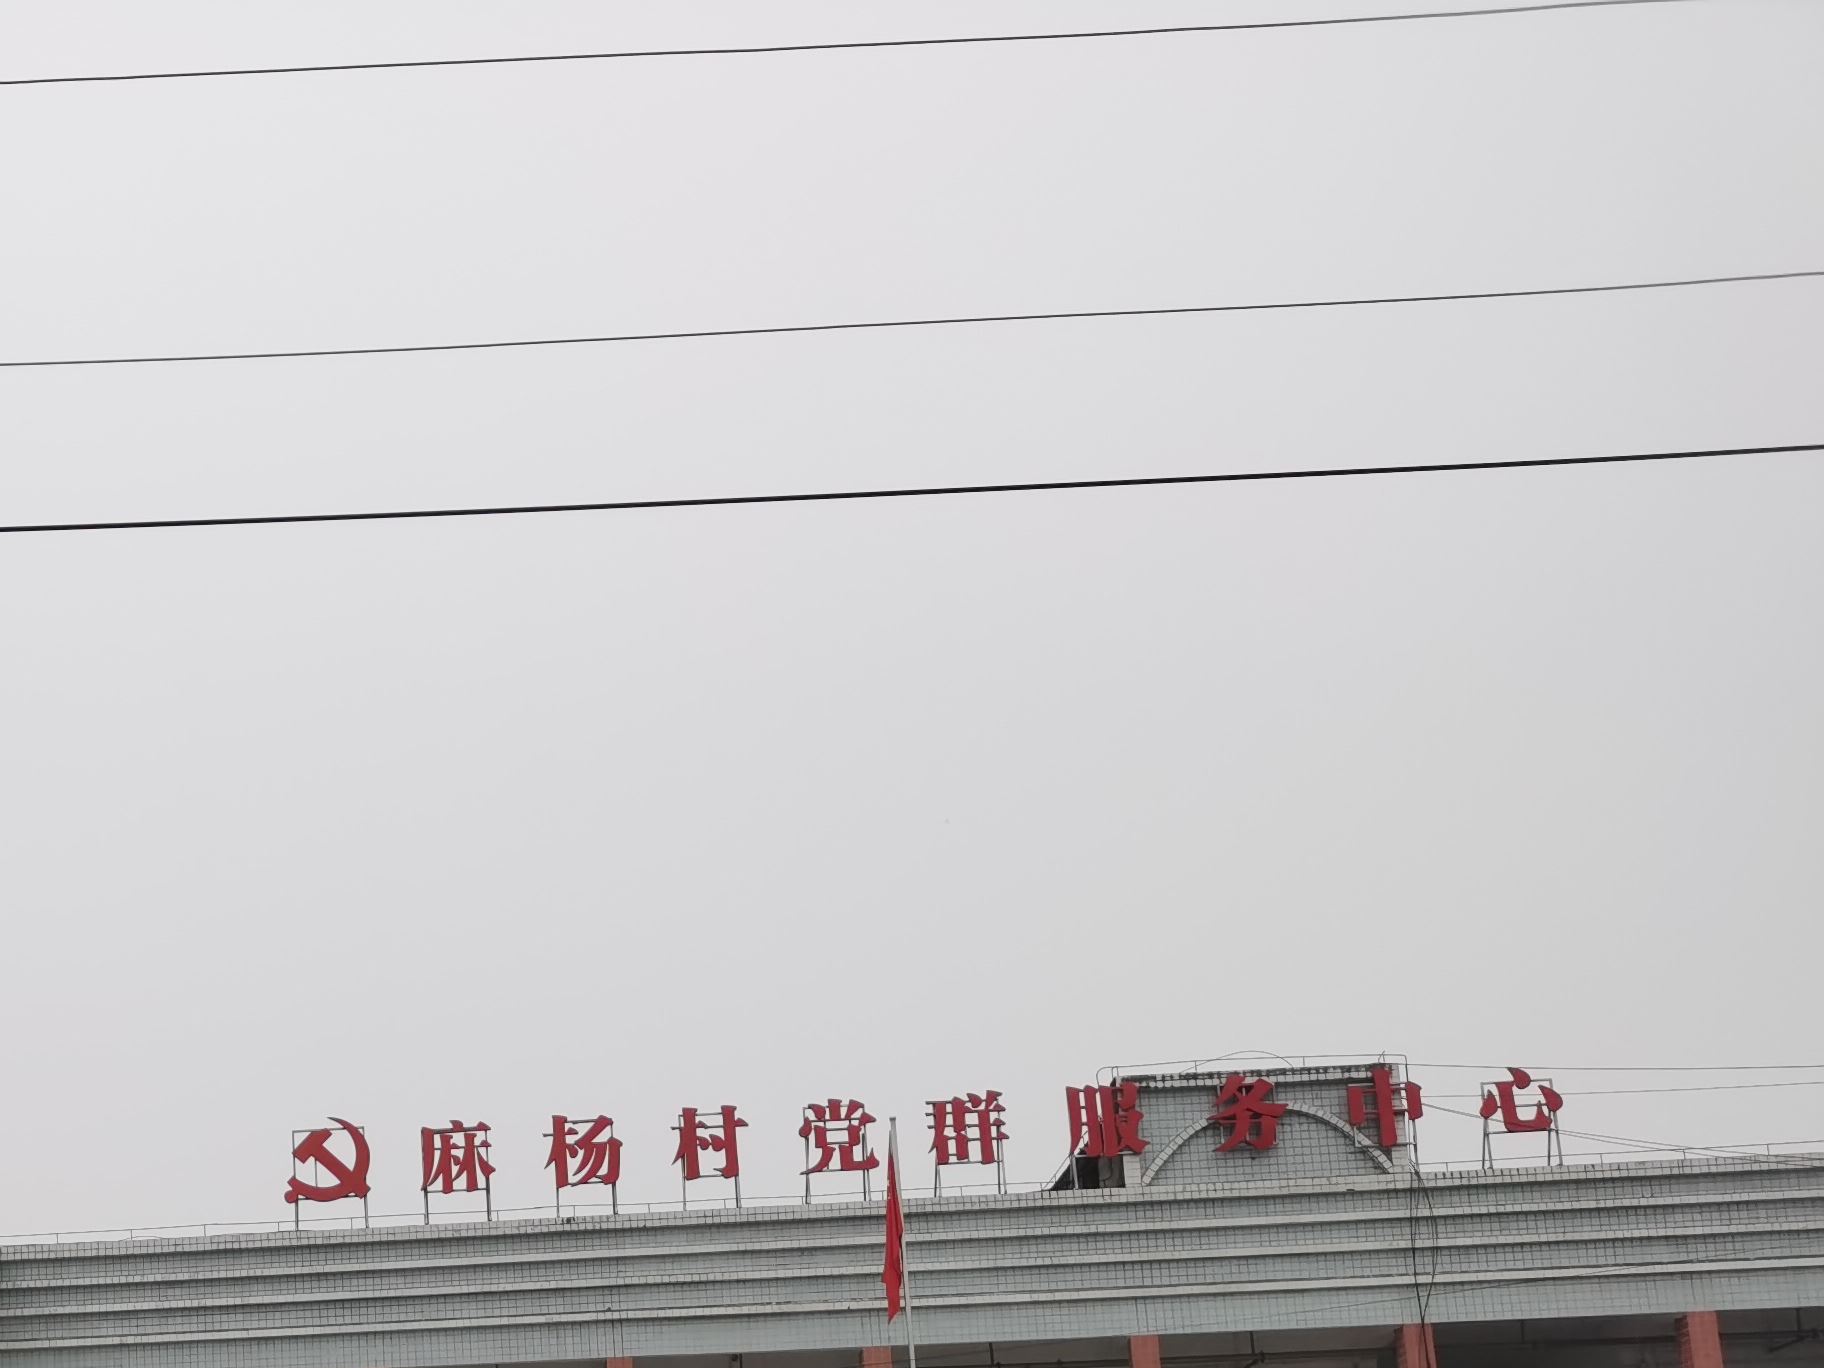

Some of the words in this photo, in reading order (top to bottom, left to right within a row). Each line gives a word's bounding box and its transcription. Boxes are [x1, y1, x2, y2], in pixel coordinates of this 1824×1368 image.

[420, 1068, 1562, 1194] 麻杨村党群服务中心
